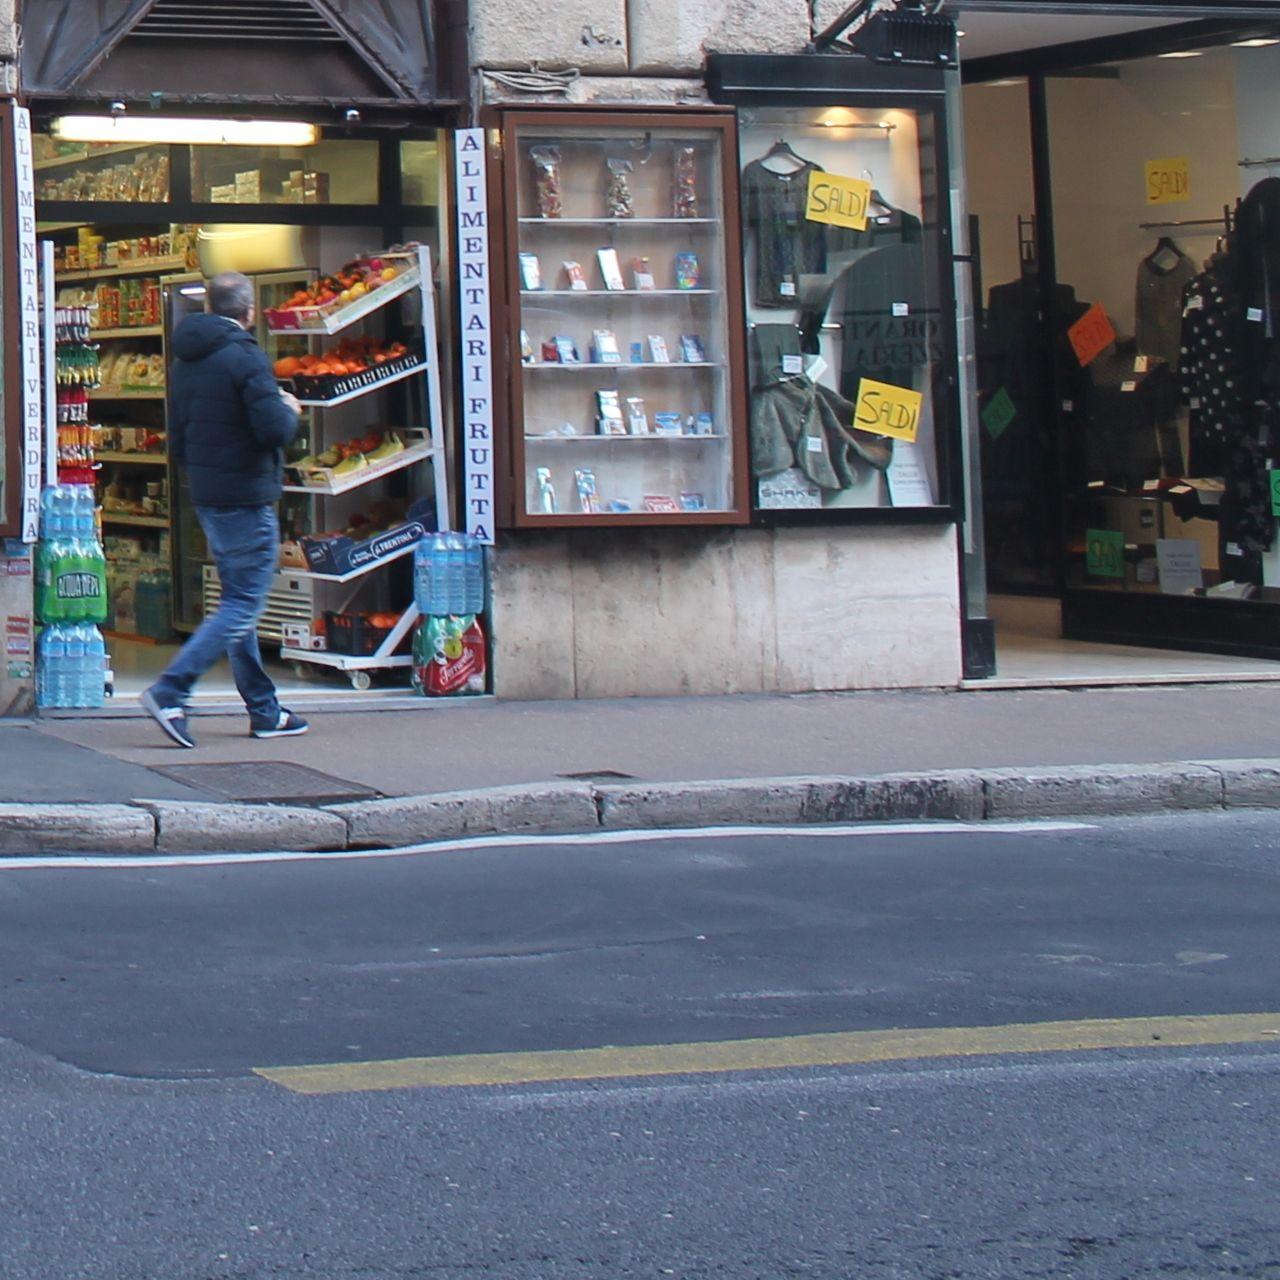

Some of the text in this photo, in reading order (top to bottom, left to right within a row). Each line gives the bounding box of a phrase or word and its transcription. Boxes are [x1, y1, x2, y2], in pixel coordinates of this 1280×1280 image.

[17, 113, 39, 537] ALIMENTARI VERDURA
[460, 135, 490, 540] ALIMENTARI FRUTTA
